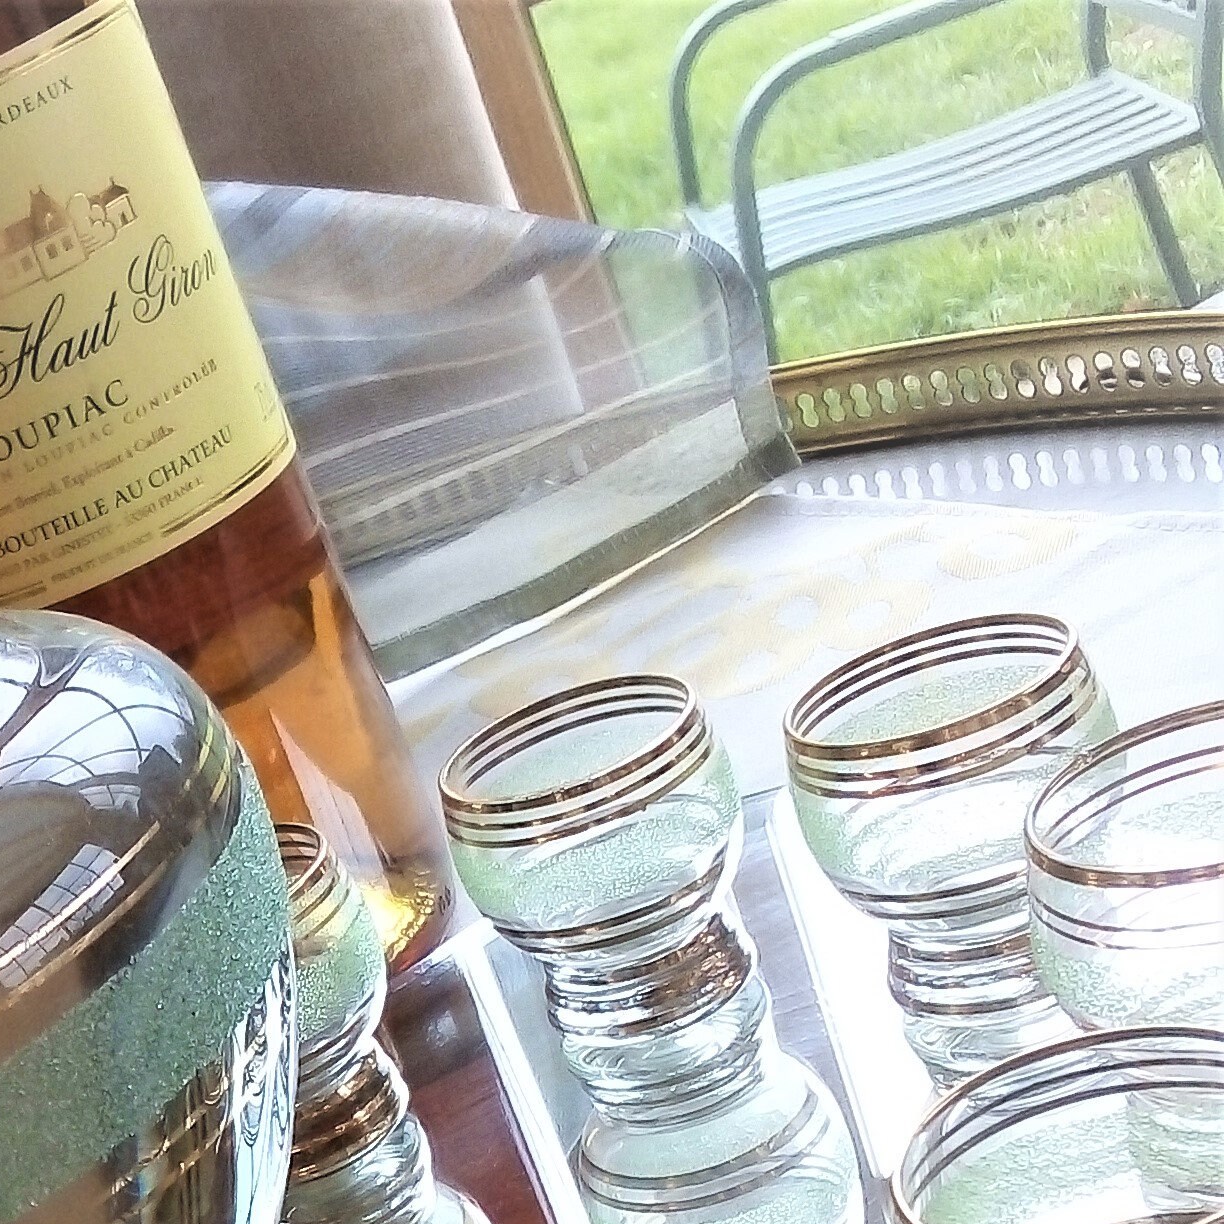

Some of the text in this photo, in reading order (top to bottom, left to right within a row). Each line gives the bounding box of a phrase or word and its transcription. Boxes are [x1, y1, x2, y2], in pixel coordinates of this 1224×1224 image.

[127, 233, 217, 324] Giron
[22, 422, 114, 473] LOUPIAC
[114, 479, 144, 509] AU
[147, 424, 233, 489] CHATEAU
